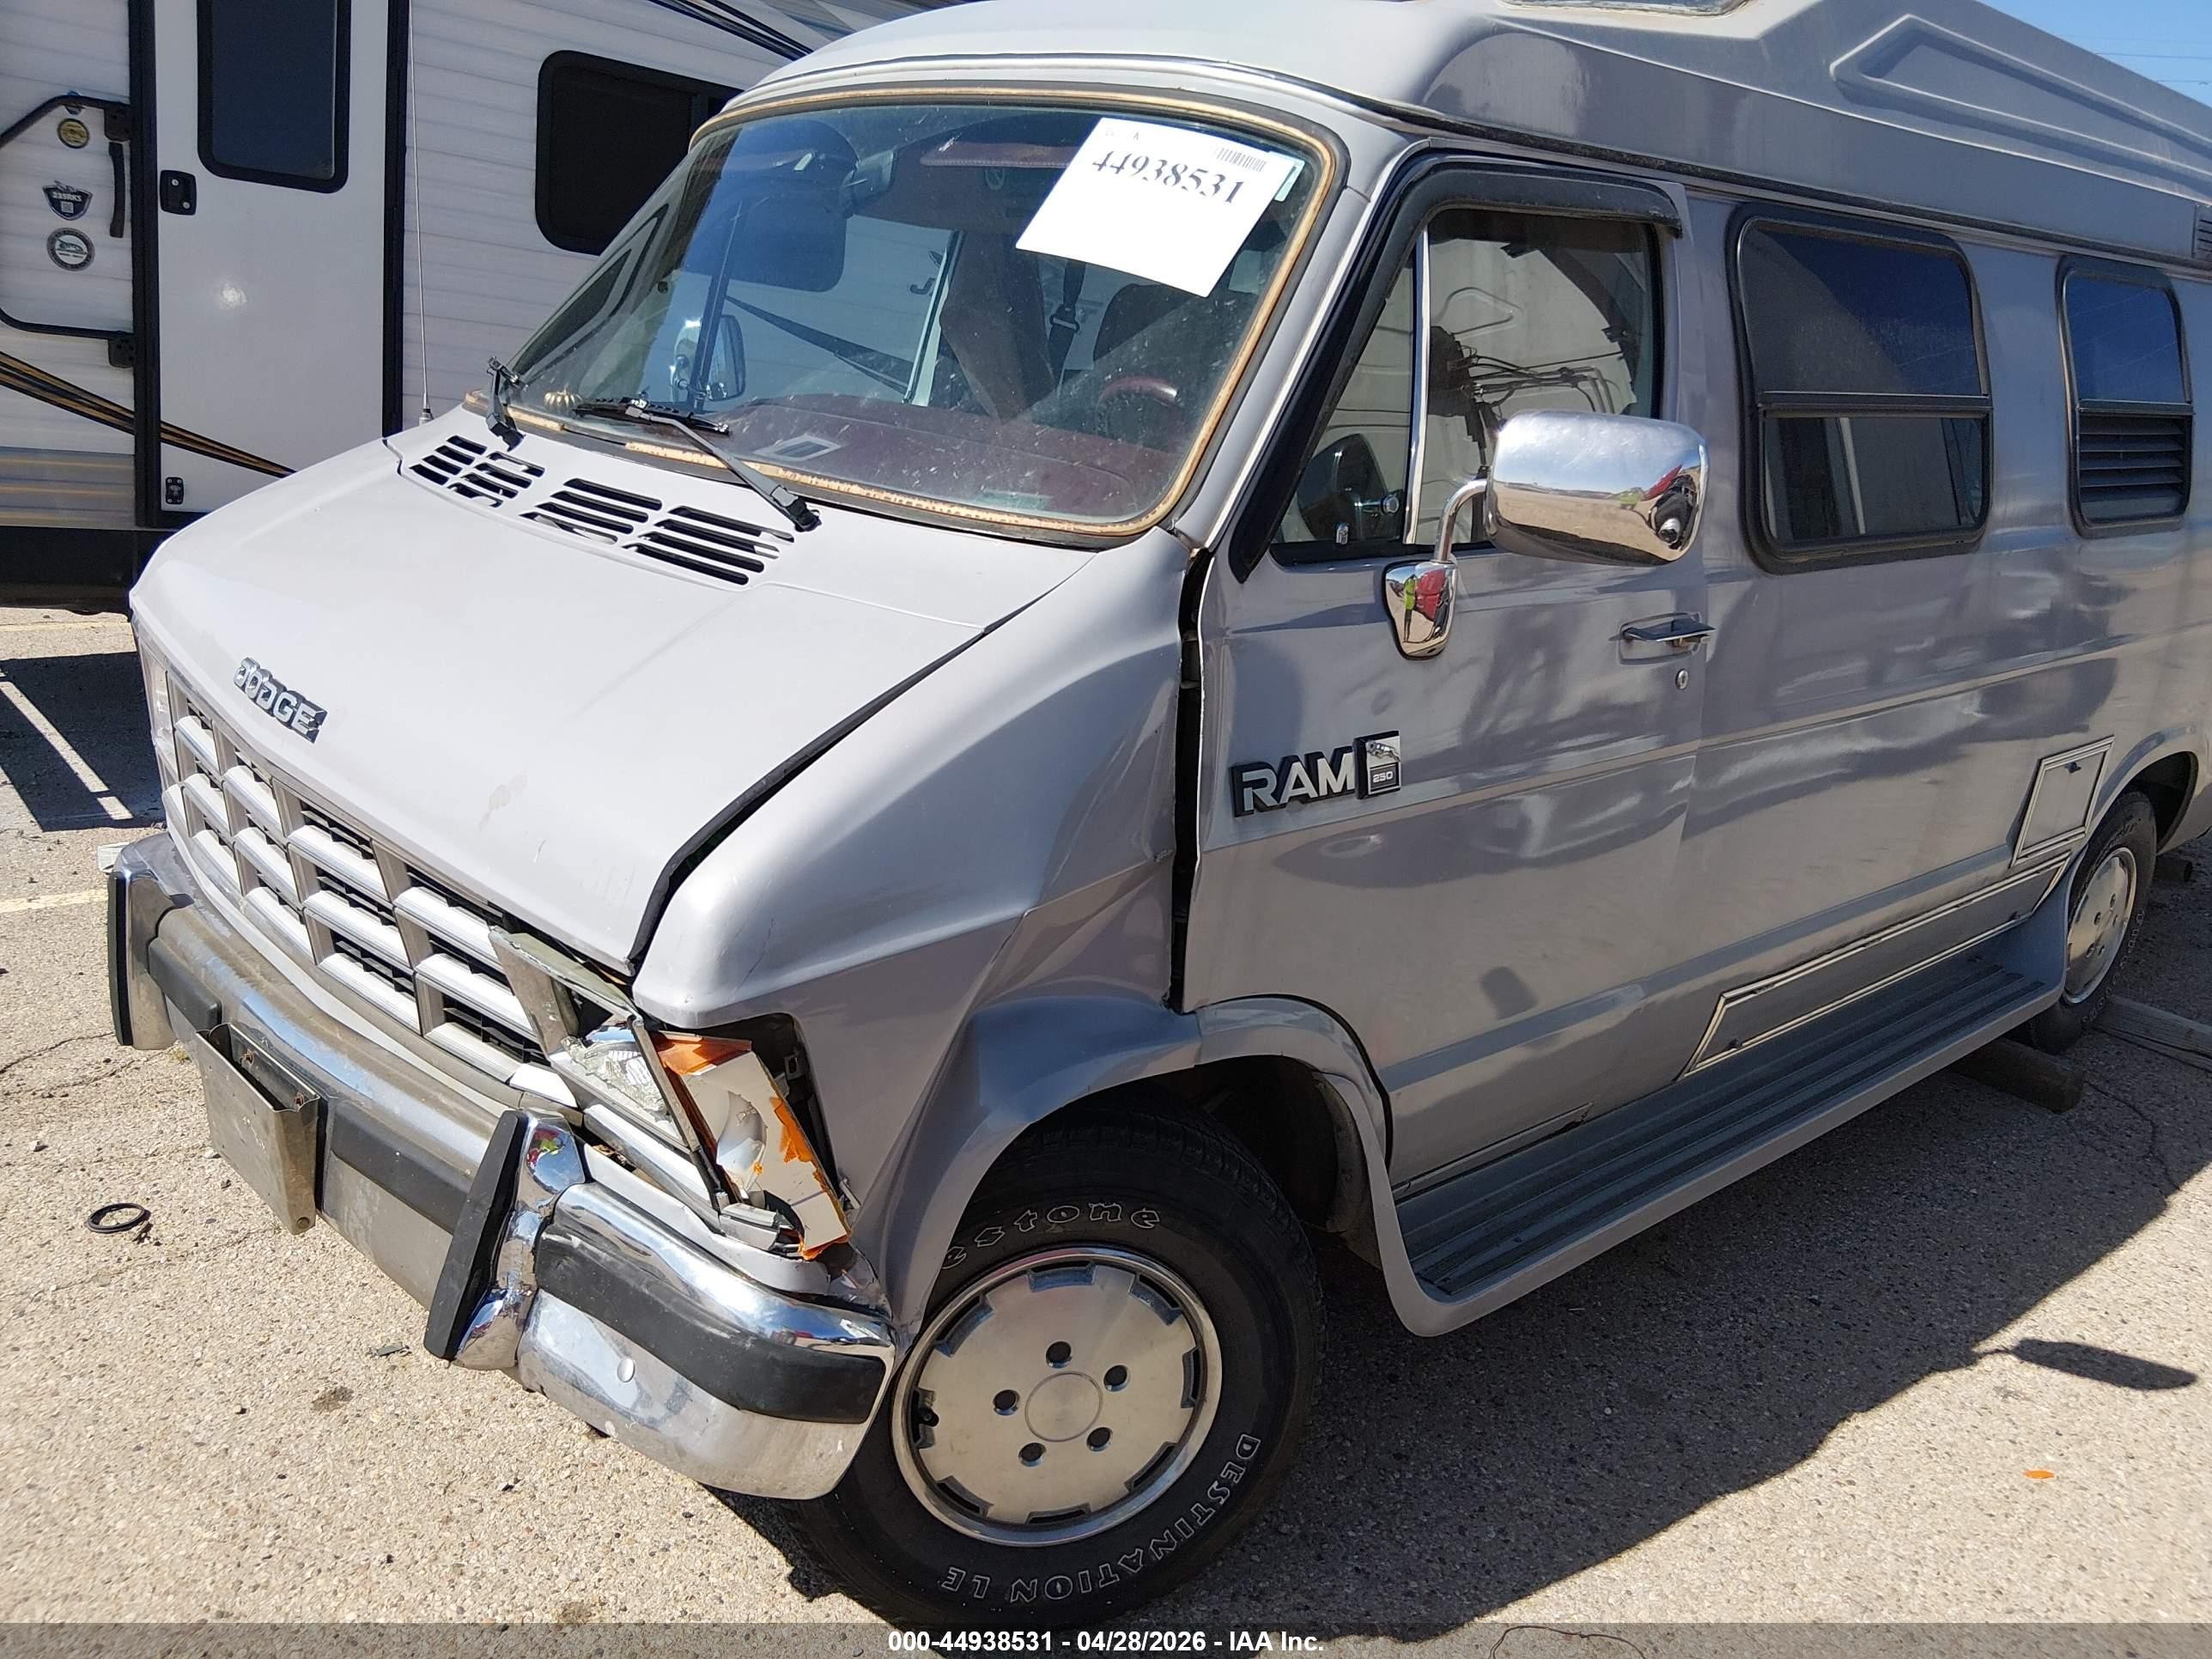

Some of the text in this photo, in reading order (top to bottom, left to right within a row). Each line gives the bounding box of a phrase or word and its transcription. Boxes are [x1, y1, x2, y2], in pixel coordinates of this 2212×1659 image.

[1092, 150, 1244, 204] 44938531
[234, 657, 328, 744] DODGE
[1231, 746, 1355, 816] RAM
[940, 1433, 1261, 1602] DESTINATION LE
